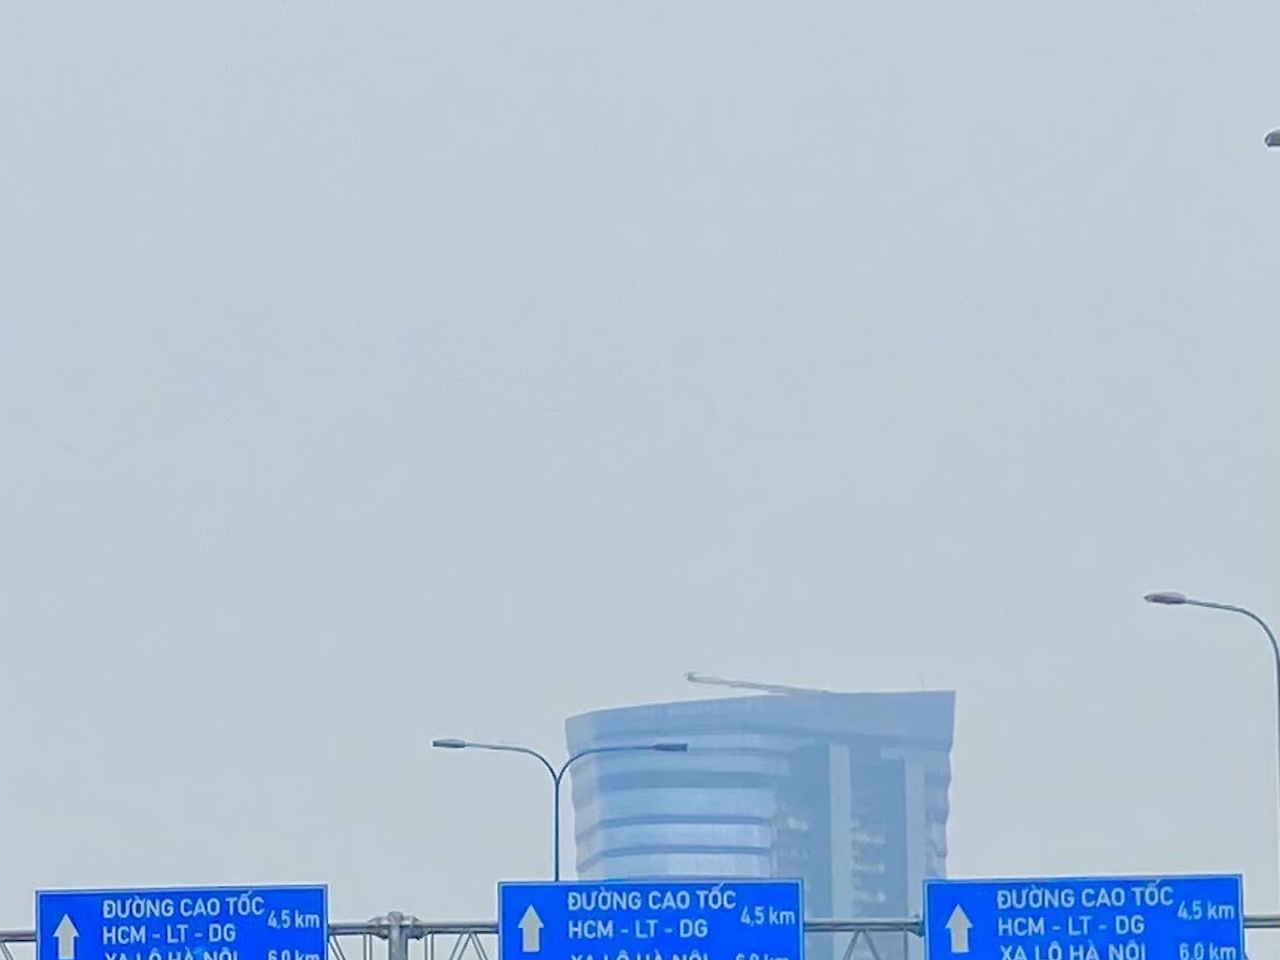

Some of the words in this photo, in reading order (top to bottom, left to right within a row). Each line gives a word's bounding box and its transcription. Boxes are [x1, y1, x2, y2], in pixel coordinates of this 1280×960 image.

[102, 896, 175, 919] ĐƯỜNG
[179, 897, 221, 918] CAO
[224, 889, 266, 916] TỐC
[567, 886, 642, 911] ĐƯỜNG
[647, 890, 691, 910] CAO
[695, 881, 737, 910] TỐC
[996, 884, 1076, 910] ĐƯỜNG
[1081, 887, 1126, 907] CAO
[1129, 879, 1175, 906] TỐC
[294, 909, 320, 928] km
[768, 905, 796, 925] km
[1207, 900, 1235, 919] km
[102, 925, 146, 945] HCM
[166, 924, 189, 943] LT
[208, 923, 237, 943] DG
[567, 919, 614, 939] HCM
[635, 919, 659, 938] LT
[679, 919, 709, 938] DG
[997, 916, 1045, 937] HCM
[1068, 915, 1092, 935] LT
[1115, 914, 1145, 935] DG
